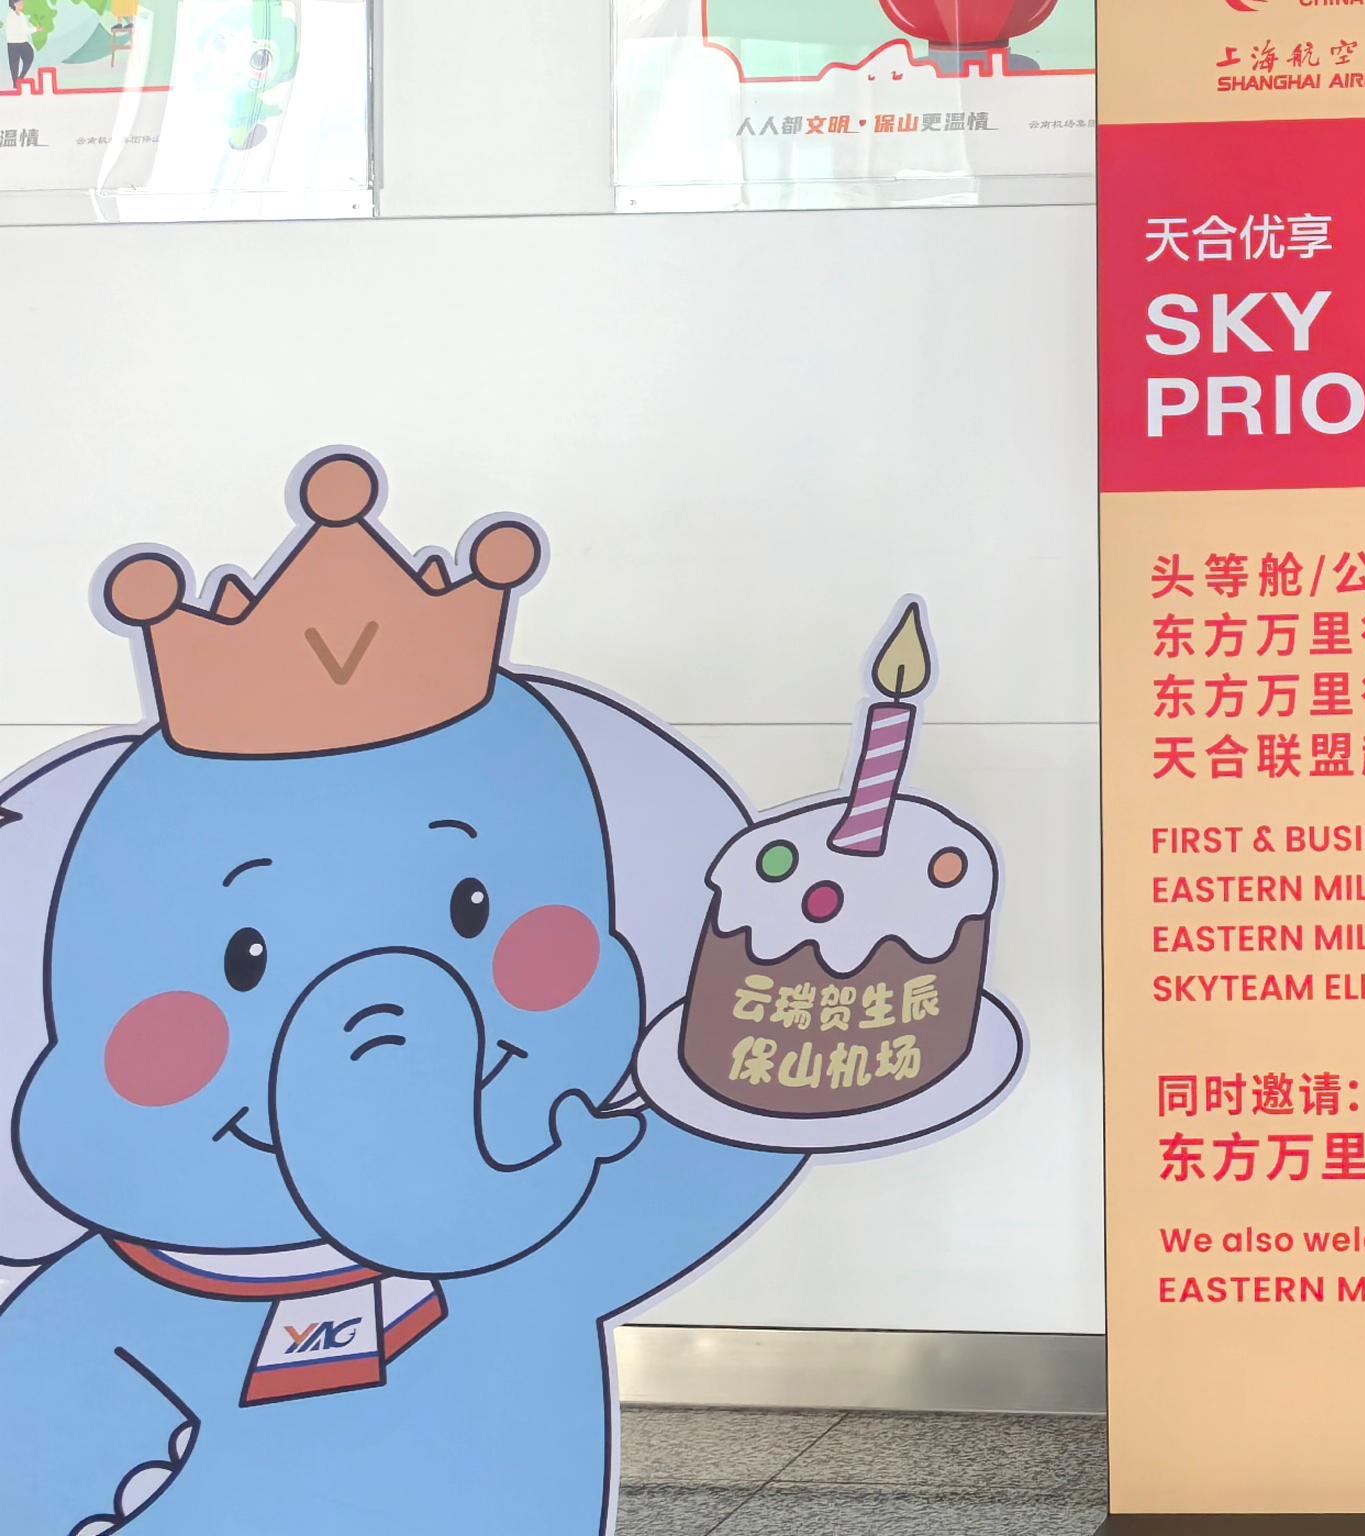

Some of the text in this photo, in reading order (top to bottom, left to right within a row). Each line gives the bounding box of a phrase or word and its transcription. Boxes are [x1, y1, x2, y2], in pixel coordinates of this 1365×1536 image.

[1217, 73, 1321, 92] SHANGHAI
[1145, 212, 1333, 263] 天合优享
[1145, 291, 1332, 356] SKY
[1152, 826, 1243, 853] FIRST
[1252, 825, 1275, 852] &
[1152, 875, 1303, 903] EASTERN
[1152, 925, 1303, 952] EASTERN
[1152, 974, 1314, 1002] SKYTEAM
[732, 974, 940, 1032] 云瑞贺生辰
[728, 1034, 921, 1089] 保山机场
[1160, 1228, 1212, 1253] We
[1222, 1226, 1294, 1253] also
[1159, 1276, 1325, 1303] EASTERN
